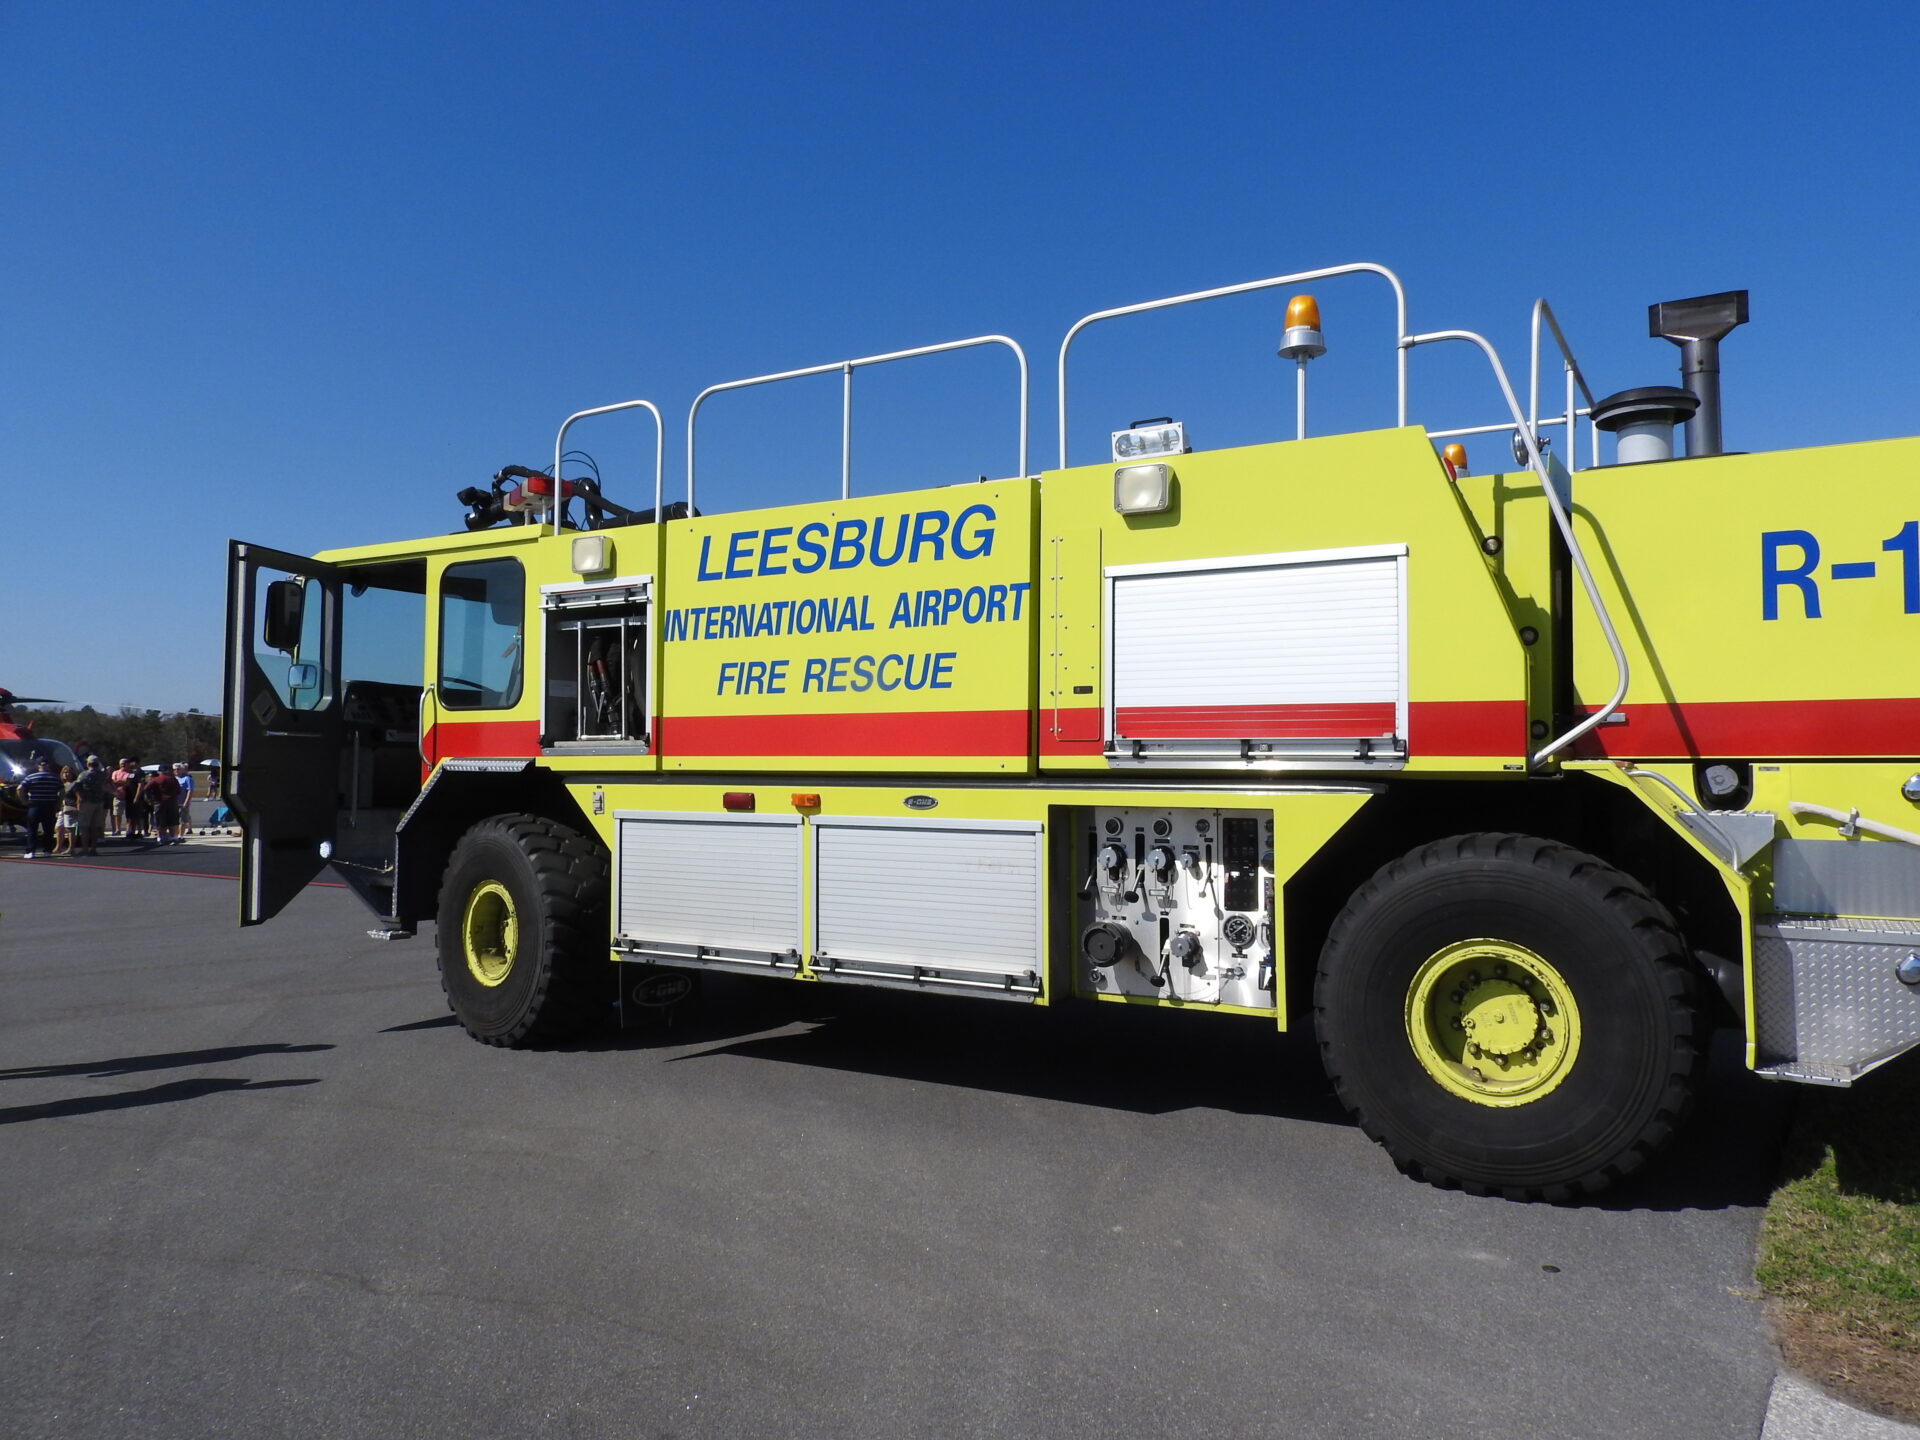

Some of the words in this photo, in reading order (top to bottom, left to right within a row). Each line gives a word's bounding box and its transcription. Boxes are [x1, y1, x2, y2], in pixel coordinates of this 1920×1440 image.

[697, 504, 996, 582] LEESBURG
[1762, 520, 1920, 620] R-1
[664, 595, 874, 642] INTERNATIONAL
[889, 582, 1031, 629] AIRPORT
[718, 660, 789, 695] FIRE
[803, 652, 957, 693] RESCUE
